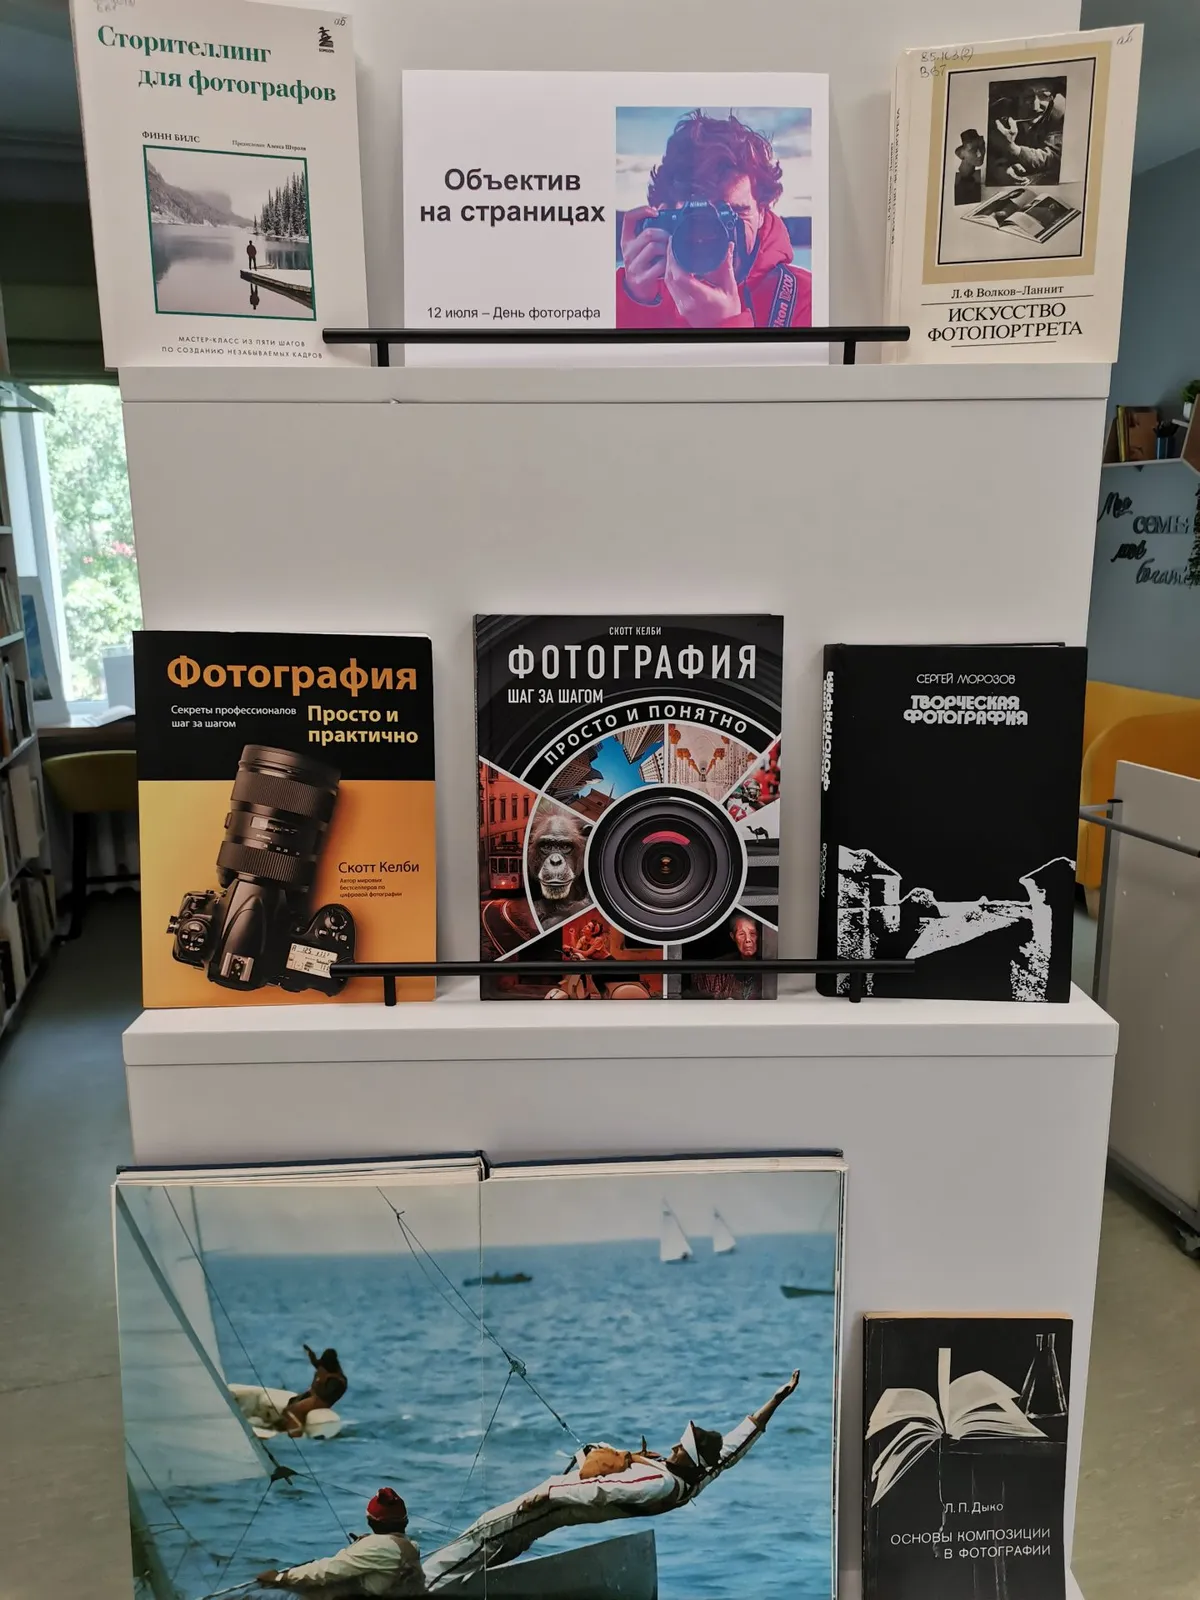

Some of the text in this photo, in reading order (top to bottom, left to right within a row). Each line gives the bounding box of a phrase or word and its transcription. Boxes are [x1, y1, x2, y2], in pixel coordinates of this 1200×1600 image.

[98, 25, 271, 62] Сторителлинг
[138, 69, 337, 104] для фотографов
[142, 131, 200, 143] ФИНН БИЛС
[444, 168, 581, 191] Объектив
[420, 205, 605, 227] на страницах
[951, 289, 962, 299] Л.
[428, 307, 442, 318] 12
[445, 309, 478, 319] июля
[493, 307, 526, 321] День
[529, 307, 601, 322] фотографа
[948, 302, 1066, 322] ИСКУССТВО
[928, 321, 1083, 342] ФОТОПОРТРЕТА
[178, 336, 239, 345] МАСТЕР-КЛАСС
[177, 346, 224, 355] СОЗДАНИЮ
[228, 348, 289, 357] НЕЗАБЫВАЕМЫХ
[292, 351, 323, 359] КАДРОВ
[608, 626, 662, 636] СКОТТ КЕЛБИ
[508, 644, 756, 680] ФОТОГРАФИЯ
[167, 655, 417, 697] Фотография
[916, 673, 1015, 685] СЕРГЕЙ МОРОЗОВ
[508, 689, 603, 704] ШАГ ЗА ШАГОМ
[911, 695, 1020, 710] ТВОРЧЕСКАЯ
[171, 705, 297, 716] Секреты профессионалов
[307, 705, 399, 725] Просто и
[903, 709, 1028, 725] ФОТОГРАФИЯ
[171, 719, 236, 728] шаг за шагом
[308, 730, 419, 746] практично
[543, 704, 748, 765] ПРОСТО И ПОНЯТНО
[338, 861, 419, 873] Скотт Келби
[944, 1501, 1004, 1514] Л. П. Дыко
[890, 1528, 1051, 1545] ОСНОВЫ КОМПОЗИЦИИ
[944, 1545, 1051, 1559] В ФОТОГРАФИИ
